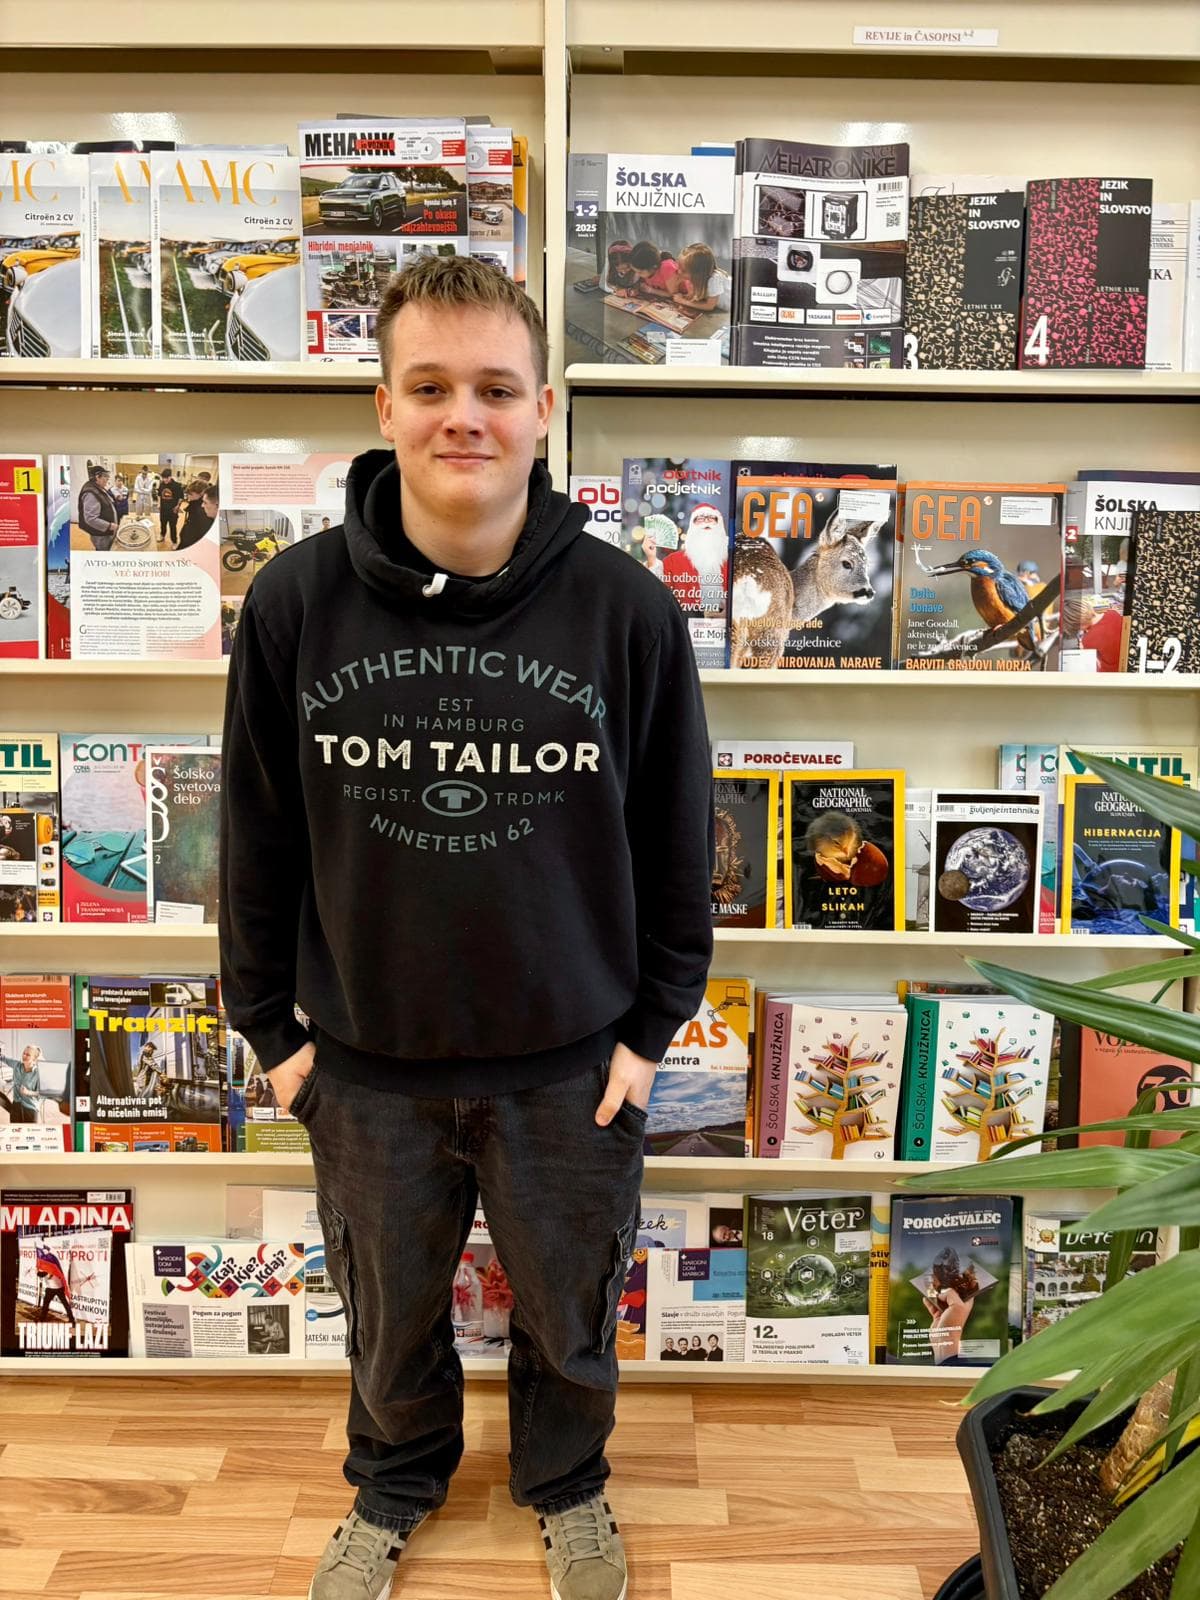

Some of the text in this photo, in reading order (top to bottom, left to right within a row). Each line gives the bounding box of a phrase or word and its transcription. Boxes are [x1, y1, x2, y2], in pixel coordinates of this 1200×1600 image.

[865, 30, 961, 42] REVIJE in ČASOPISI
[305, 132, 396, 157] MEHANIK
[168, 159, 278, 206] AMC
[616, 167, 687, 188] ŠOLSKA
[1100, 180, 1128, 190] JEZIK
[616, 188, 705, 208] KNJIŽNICA
[970, 196, 997, 206] JEZIK
[1100, 192, 1112, 202] IN
[576, 204, 598, 216] 1-2
[969, 208, 980, 218] IN
[1100, 204, 1150, 214] SLOVSTVO
[24, 213, 54, 221] Citroën
[244, 216, 293, 226] Citroën 2 CV
[968, 220, 1020, 230] SLOVSTVO
[308, 242, 374, 253] Hibridni menjalnik
[1024, 316, 1050, 366] 4
[904, 334, 918, 370] 3
[22, 470, 34, 492] 1
[646, 482, 721, 496] podjetnik
[1094, 495, 1158, 512] ŠOLSKA
[742, 492, 813, 538] GEA
[912, 495, 982, 540] GEA
[84, 560, 136, 568] AVTO-MOTO
[138, 559, 163, 568] ŠPORT
[672, 572, 702, 583] odbor
[910, 587, 936, 599] Delta
[910, 602, 944, 613] Donave
[908, 619, 960, 629] Jane Goodall,
[694, 629, 705, 638] dr.
[781, 636, 842, 651] razglednice
[1136, 636, 1182, 674] 1-2
[777, 656, 882, 668] MIROVANJA NARAVE
[906, 658, 1032, 671] BARVITI GRADOVI MORJA
[301, 646, 606, 728] AUTHENTIC WEAR
[438, 698, 474, 712] EST
[384, 714, 524, 732] IN HAMBURG
[0, 744, 52, 768] TIL
[314, 734, 600, 774] TOM TAILOR
[744, 752, 842, 764] POROČEVALEC
[174, 766, 214, 780] Šolsko
[174, 783, 221, 792] svetova
[820, 788, 866, 798] NATIONAL
[174, 794, 200, 804] delo
[343, 784, 566, 806] REGIST. TRDMK
[812, 797, 872, 808] GEOGRAPHIC
[370, 814, 534, 852] NINETEEN 62
[1084, 828, 1161, 838] HIBERNACIJA
[155, 856, 161, 864] 2
[828, 888, 858, 896] LETO
[719, 904, 748, 915] MASKE
[822, 903, 864, 911] SLIKAH
[89, 1009, 218, 1032] Tranzit
[664, 1056, 700, 1066] entra
[766, 1012, 784, 1130] ŠOLSKA KNJIŽNICA
[912, 1009, 932, 1130] ŠOLSKA KNJIŽNICA
[96, 1094, 162, 1106] Alternativna pot
[96, 1107, 168, 1119] do ničelnih emisij
[1, 1206, 130, 1232] MLADINA
[784, 1206, 864, 1232] Veter
[904, 1212, 1002, 1229] POROČEVALEC
[762, 1232, 774, 1240] 18
[211, 1250, 287, 1284] Kaj? Kje? Kdaj?
[18, 1322, 73, 1350] TRIUMF
[754, 1325, 778, 1338] 12.
